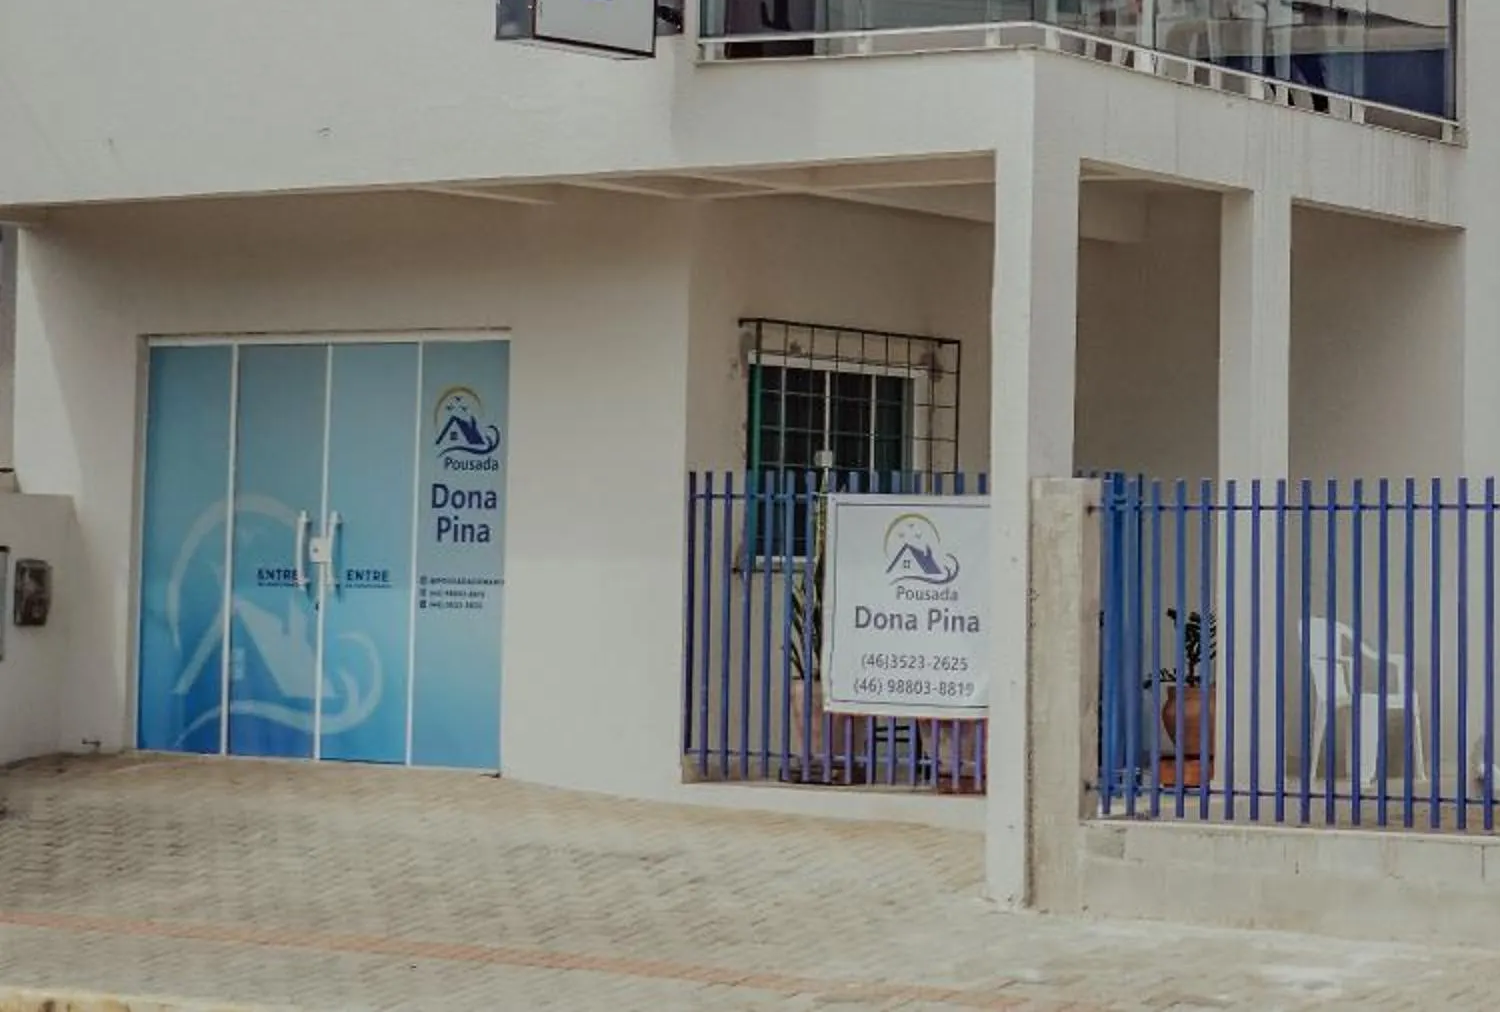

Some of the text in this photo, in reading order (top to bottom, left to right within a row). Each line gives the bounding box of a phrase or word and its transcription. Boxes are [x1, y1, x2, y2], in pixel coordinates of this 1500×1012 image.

[444, 457, 499, 470] Pousada
[431, 483, 497, 509] Dona
[437, 515, 490, 543] Pina
[346, 569, 390, 581] ENTRE
[896, 585, 959, 601] Pousada
[855, 605, 980, 633] Dona Pina
